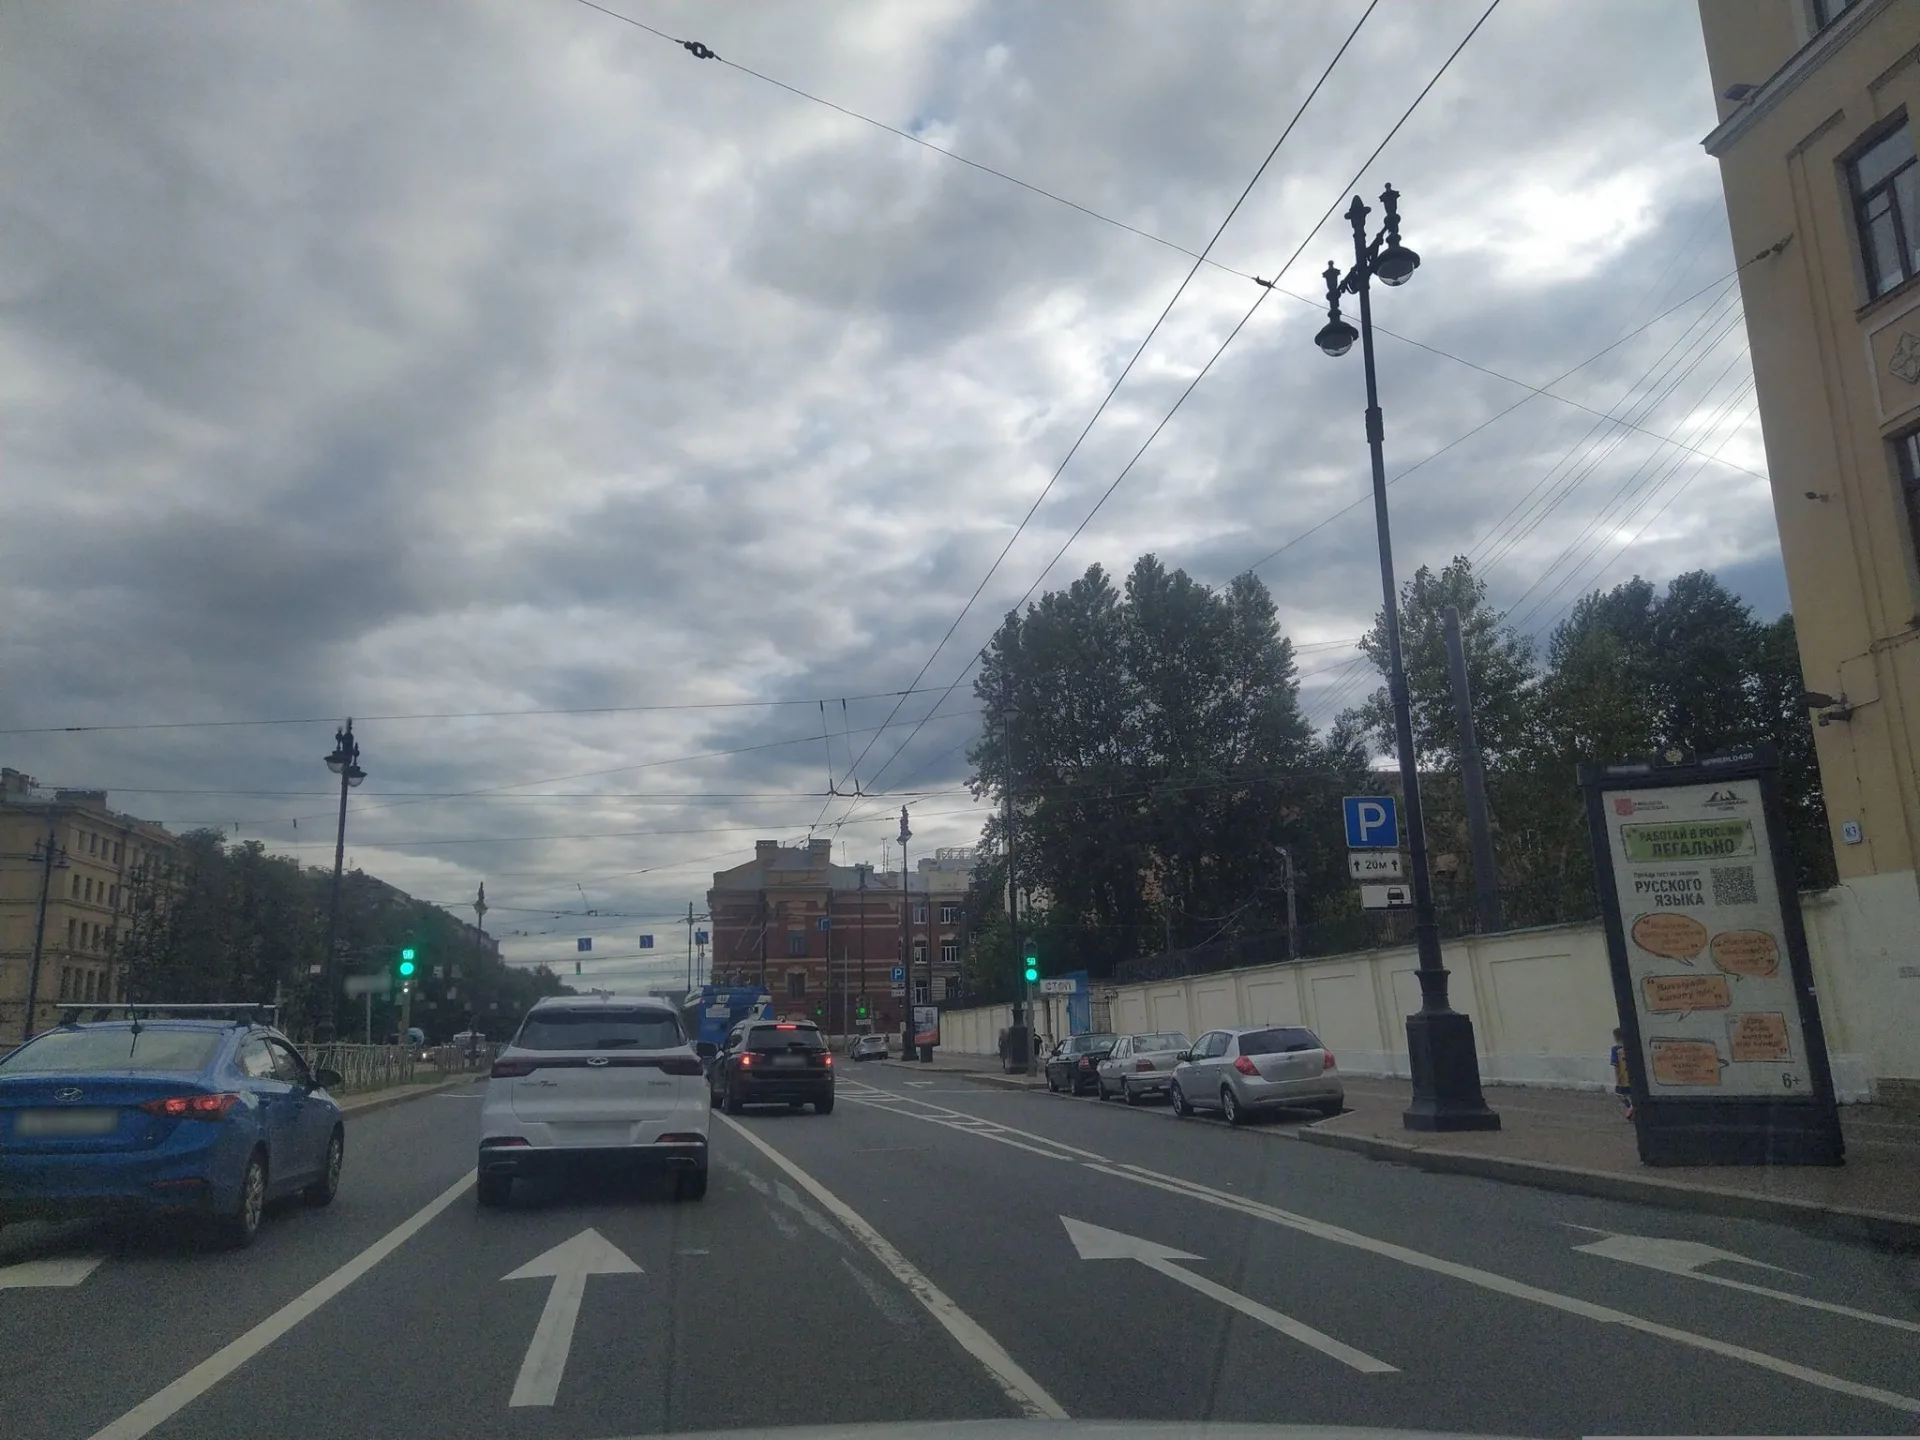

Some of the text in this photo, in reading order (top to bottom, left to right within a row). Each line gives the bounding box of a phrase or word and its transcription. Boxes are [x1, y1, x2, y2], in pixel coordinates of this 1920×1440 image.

[1358, 802, 1387, 841] P
[1639, 827, 1687, 842] РАБОТАЙ
[1690, 828, 1697, 839] В
[1652, 838, 1735, 857] ЛЕГАЛЬНО
[1634, 878, 1702, 893] РУССКОГО
[1654, 893, 1705, 907] ЯЗЫКА
[1045, 981, 1072, 991] СТОП
[1781, 1072, 1803, 1089] 6+
